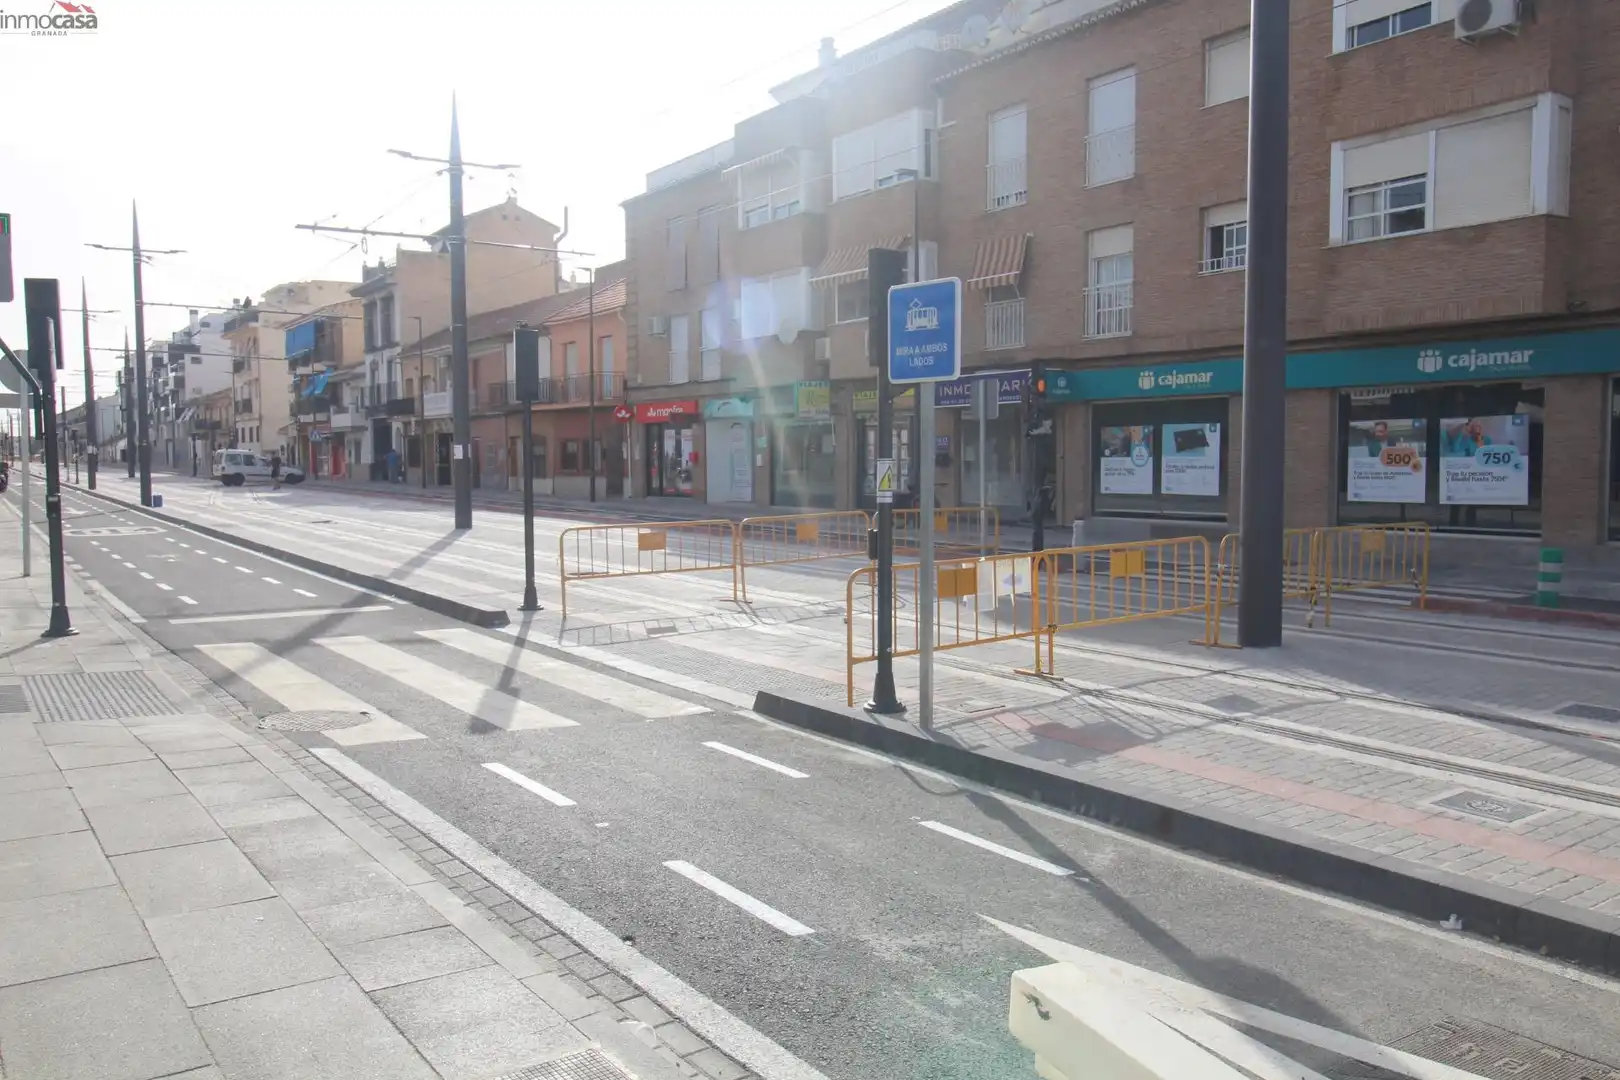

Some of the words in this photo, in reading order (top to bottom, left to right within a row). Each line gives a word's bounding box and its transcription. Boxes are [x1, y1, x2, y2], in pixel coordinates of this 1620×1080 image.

[920, 342, 948, 354] AMBOS
[909, 356, 934, 367] LADOS
[1447, 348, 1534, 372] cajamar
[1158, 369, 1214, 389] cajamar
[1386, 453, 1411, 465] 500
[1482, 452, 1511, 465] 750
